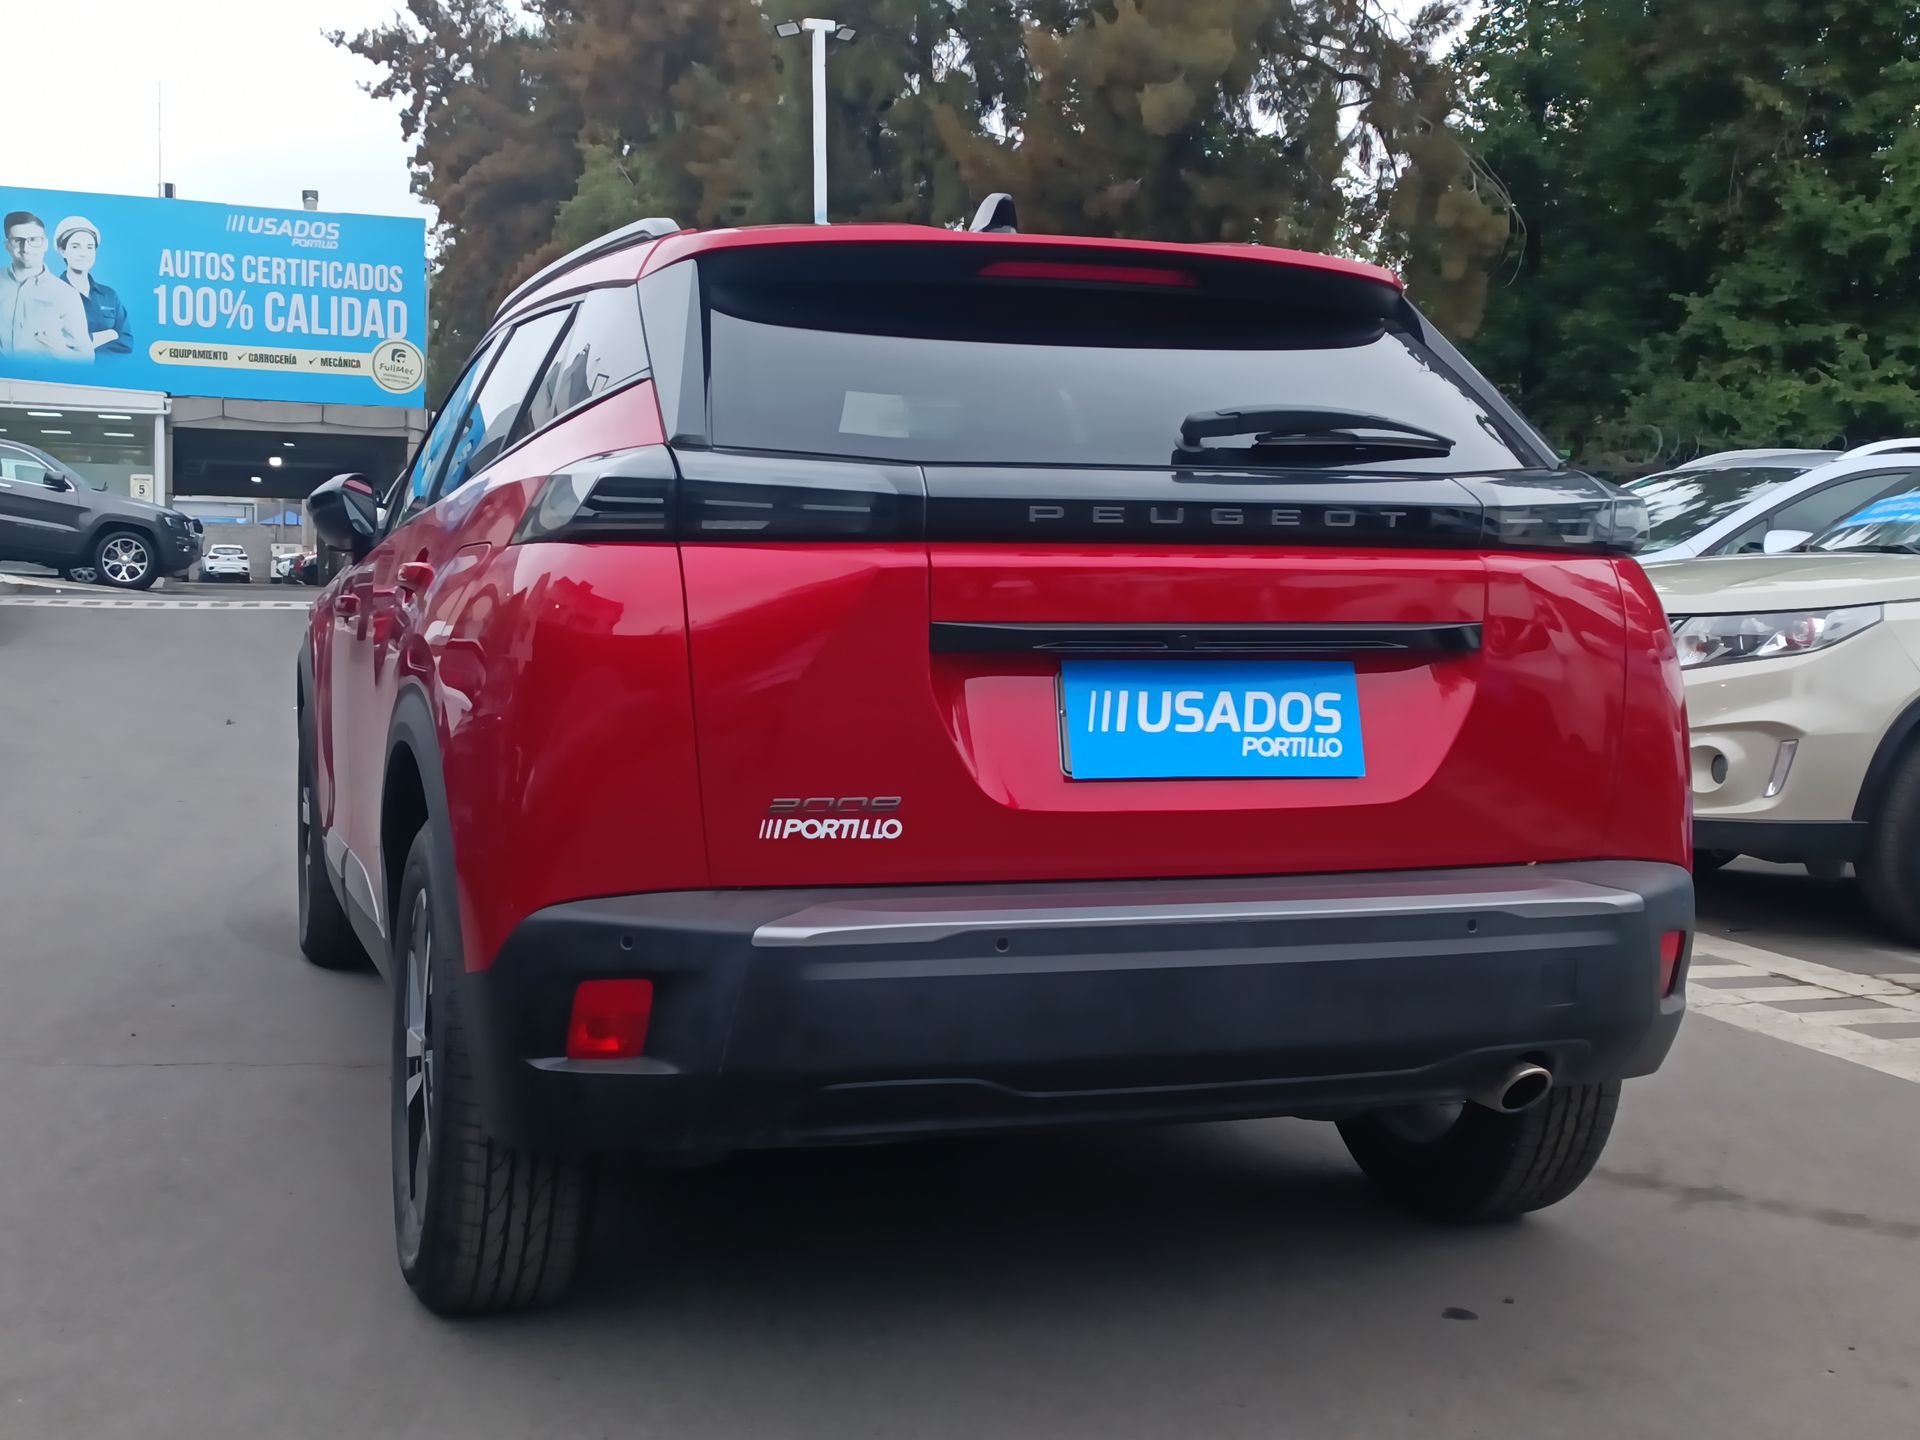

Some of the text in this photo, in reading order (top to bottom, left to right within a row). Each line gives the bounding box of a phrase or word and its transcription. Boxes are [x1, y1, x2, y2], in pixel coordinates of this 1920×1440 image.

[247, 216, 340, 240] USADOS
[159, 249, 403, 293] AUTOS CERTIFICADOS
[153, 284, 408, 339] 100% CALIDAD
[169, 348, 228, 361] EQUIPAMIENTO
[138, 484, 145, 495] 5
[1029, 505, 1407, 528] PEUGEOT
[1137, 691, 1342, 734] USADOS
[1242, 736, 1342, 757] PORTILLO
[782, 819, 903, 839] PORTILLO
